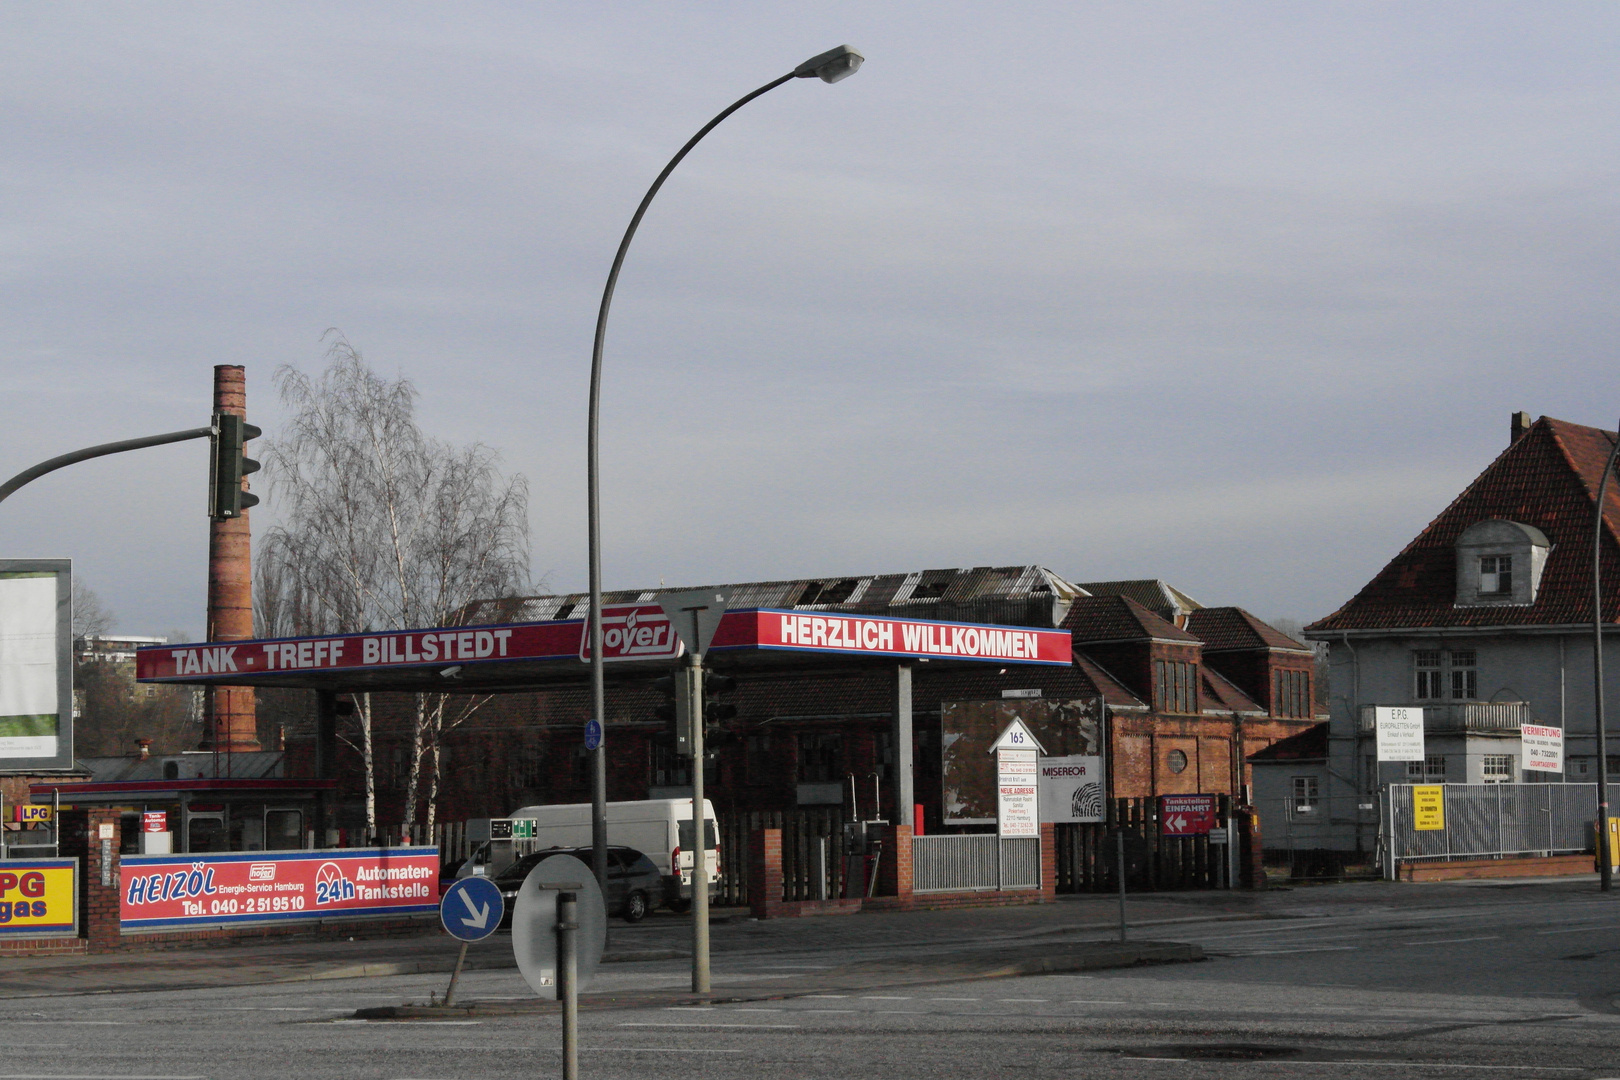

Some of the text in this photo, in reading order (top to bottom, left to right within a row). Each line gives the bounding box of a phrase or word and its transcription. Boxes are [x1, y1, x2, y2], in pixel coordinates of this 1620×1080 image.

[587, 624, 667, 654] oyer
[781, 615, 1038, 659] HERZLICH WILLKOMMEN
[172, 630, 512, 675] TANK TREFF BILLSTEDT
[1010, 732, 1024, 743] 165
[1522, 726, 1560, 738] VERMIETUNG
[1043, 766, 1086, 777] MISEREOR
[23, 807, 48, 819] LPG
[1165, 805, 1210, 813] EINFAHRT
[356, 865, 433, 882] Automaten-
[127, 862, 217, 905] HEIZÖL
[218, 882, 305, 895] Energie-Service Hamburg
[316, 877, 356, 905] 24h
[356, 882, 430, 900] Tankstelle
[182, 900, 207, 916] Tel.
[211, 899, 238, 914] 040
